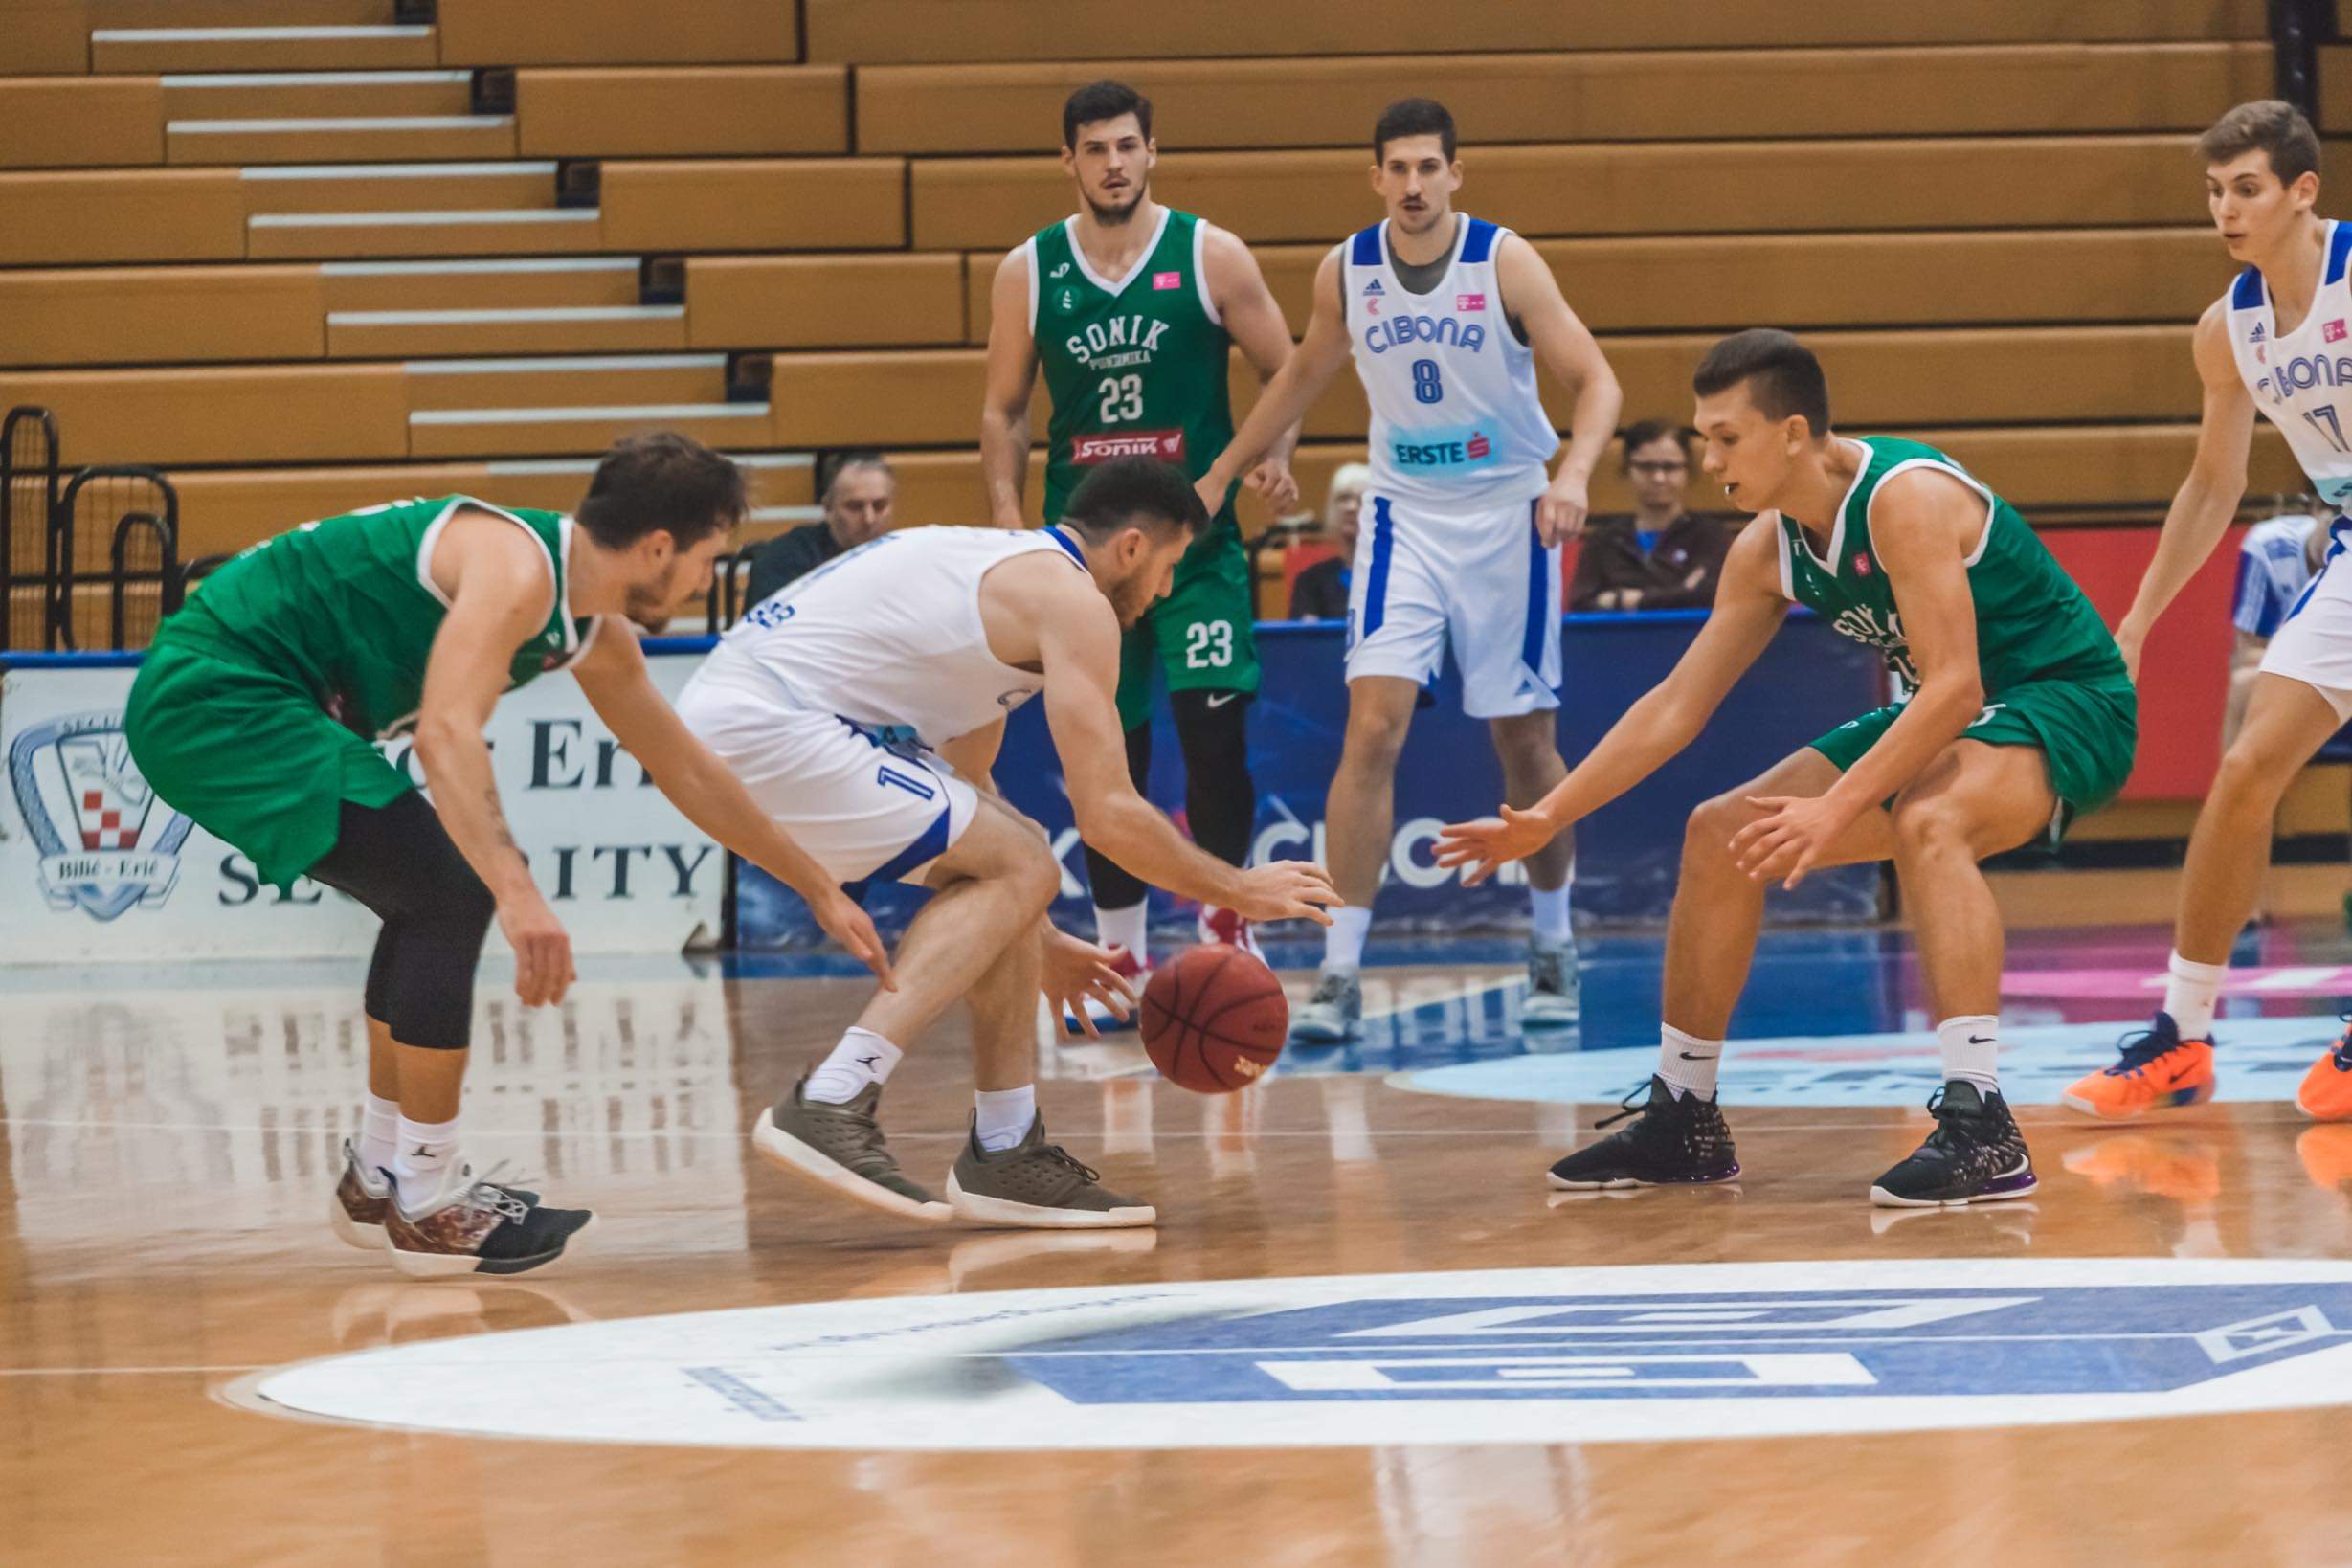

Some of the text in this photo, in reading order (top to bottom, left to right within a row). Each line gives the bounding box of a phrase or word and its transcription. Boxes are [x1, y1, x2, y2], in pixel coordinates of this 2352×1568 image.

[1066, 314, 1170, 364] SONIK
[1365, 315, 1485, 353] CIBONA
[1098, 373, 1144, 423] 23
[1412, 359, 1444, 404] 8
[2302, 404, 2351, 452] 17
[1396, 442, 1464, 464] ERSTE
[1186, 619, 1233, 668] 23
